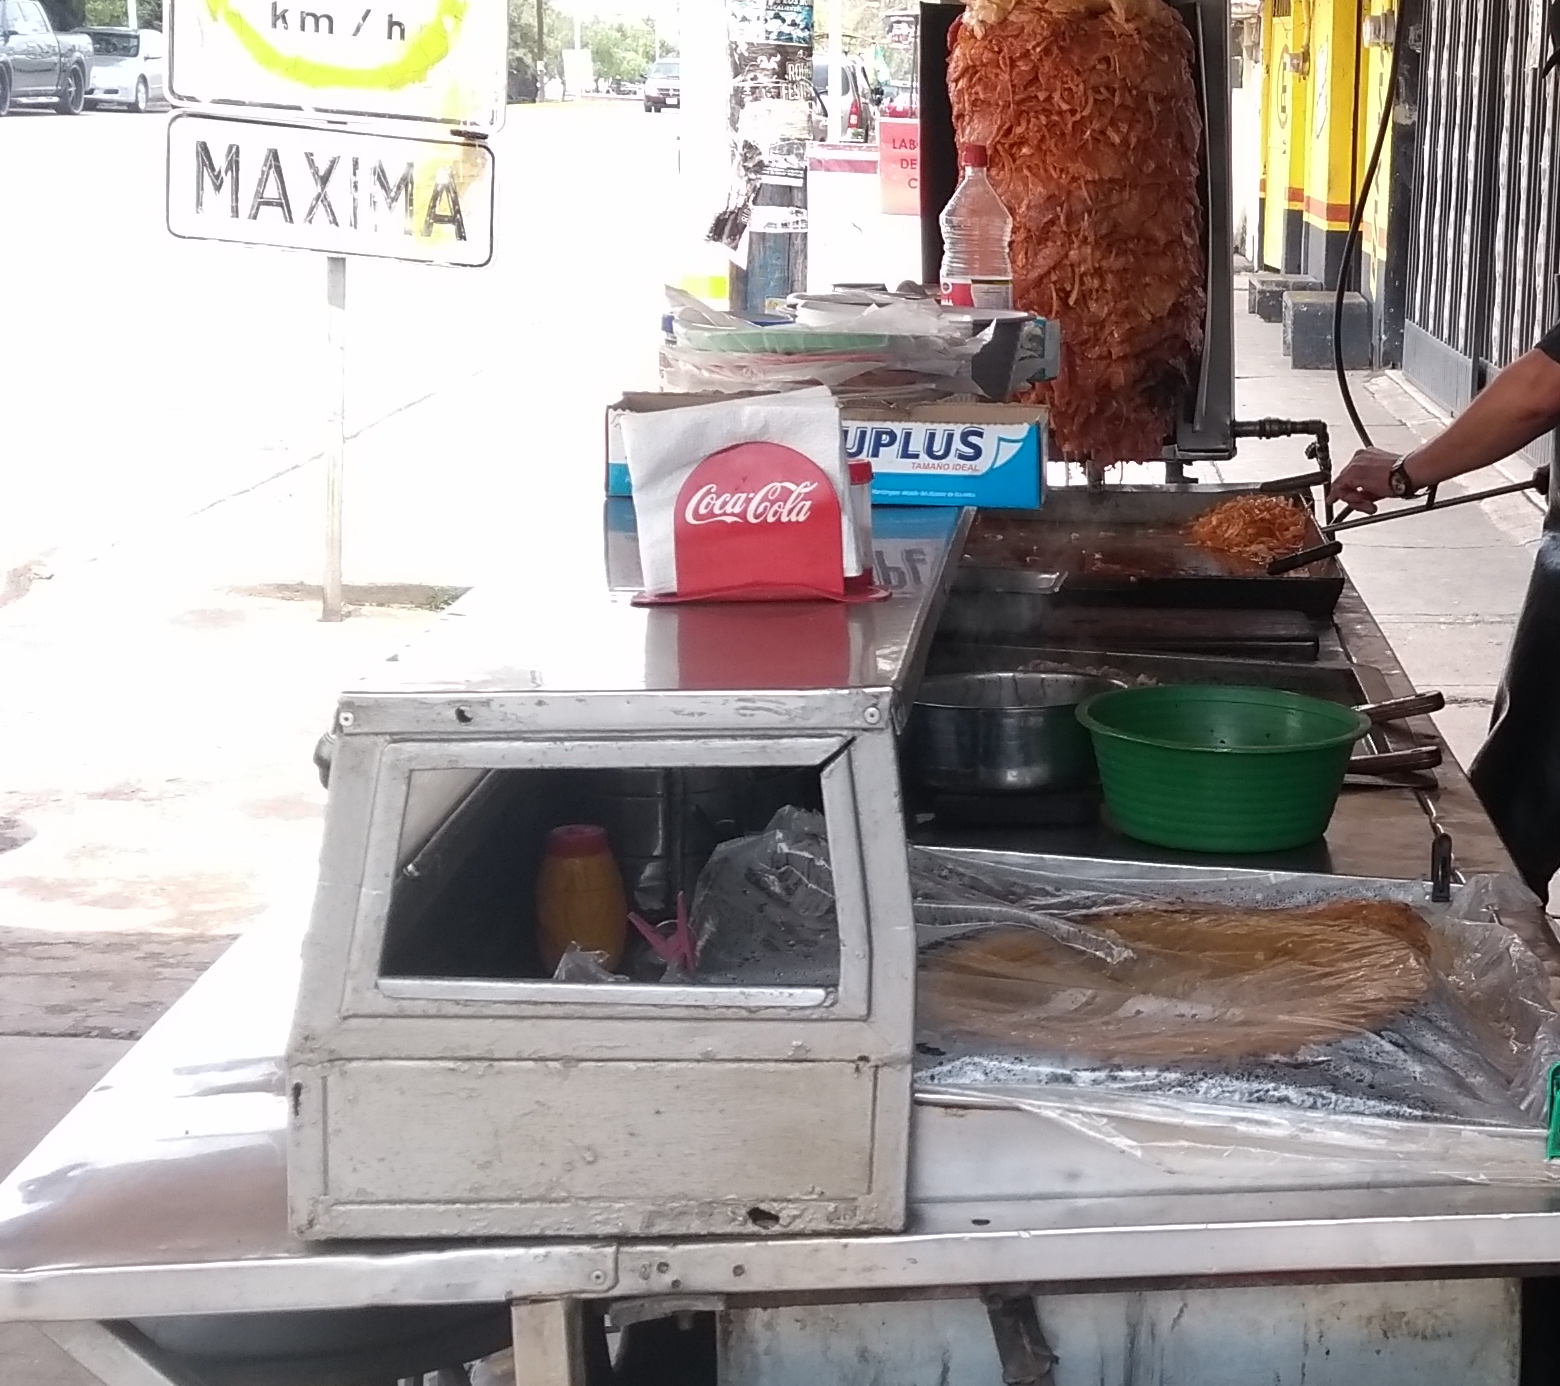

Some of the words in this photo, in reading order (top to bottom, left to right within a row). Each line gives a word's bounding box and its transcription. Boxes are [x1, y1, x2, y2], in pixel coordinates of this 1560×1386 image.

[892, 138, 918, 150] LAB
[195, 140, 467, 242] MAXIMA
[842, 425, 985, 462] UPLUS
[911, 461, 949, 471] TAMAÑO
[951, 463, 980, 472] IDEAL
[684, 481, 818, 525] Coca-Cola
